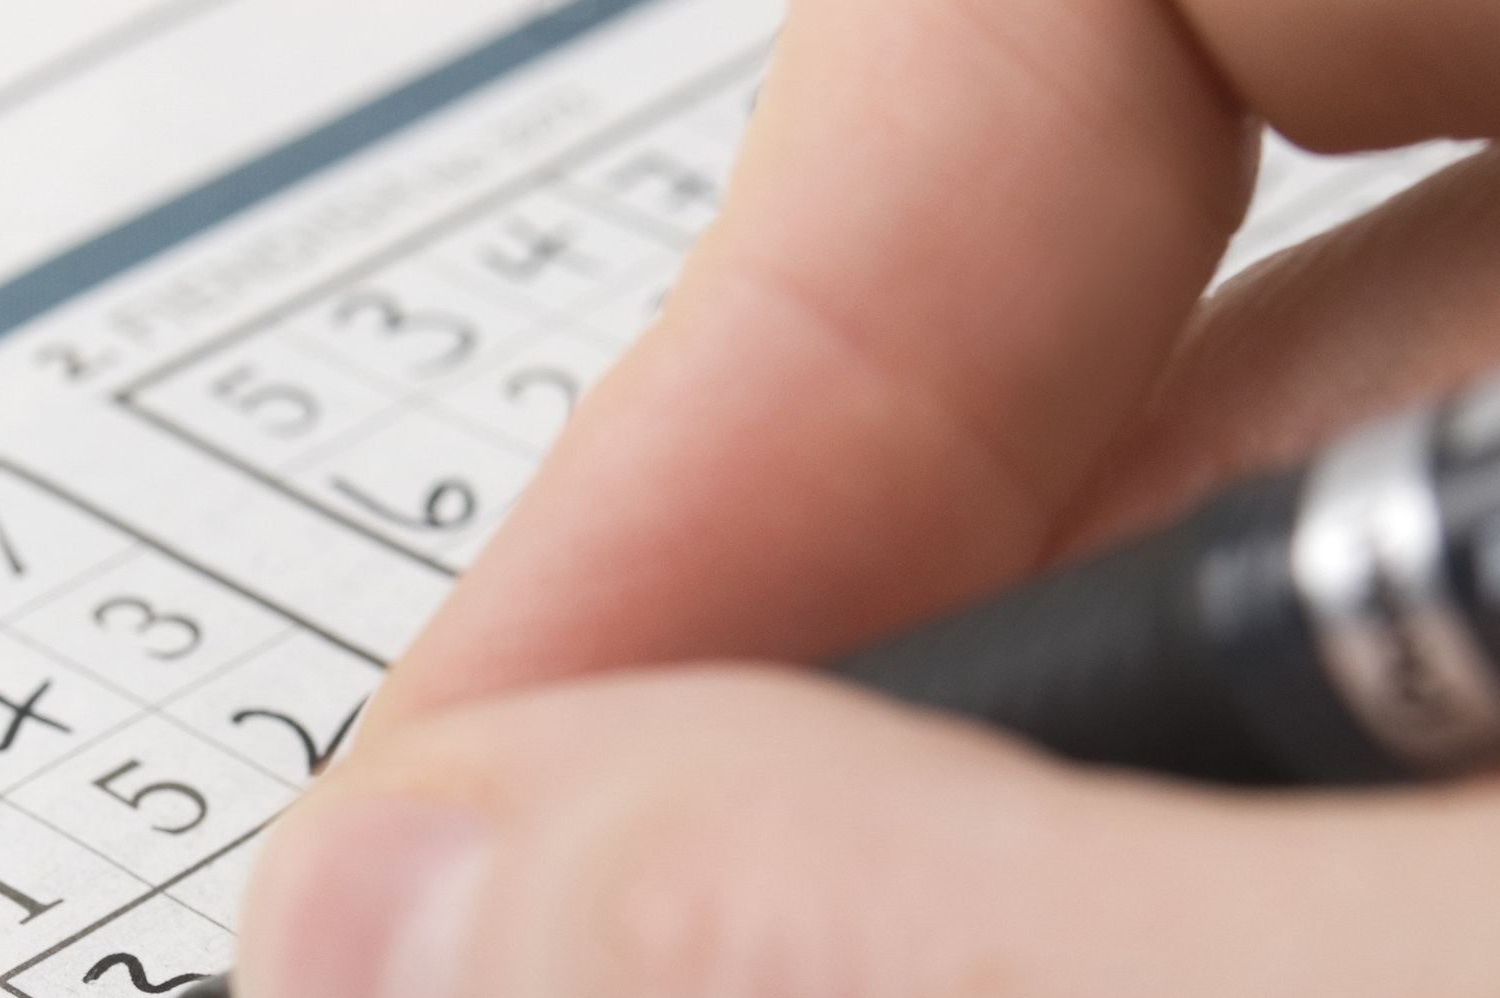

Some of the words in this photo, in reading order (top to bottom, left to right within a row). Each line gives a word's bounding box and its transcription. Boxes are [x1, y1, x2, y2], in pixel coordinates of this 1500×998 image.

[330, 477, 477, 532] 6
[93, 598, 203, 661] 3
[231, 690, 373, 775] 2
[91, 759, 208, 836] 5
